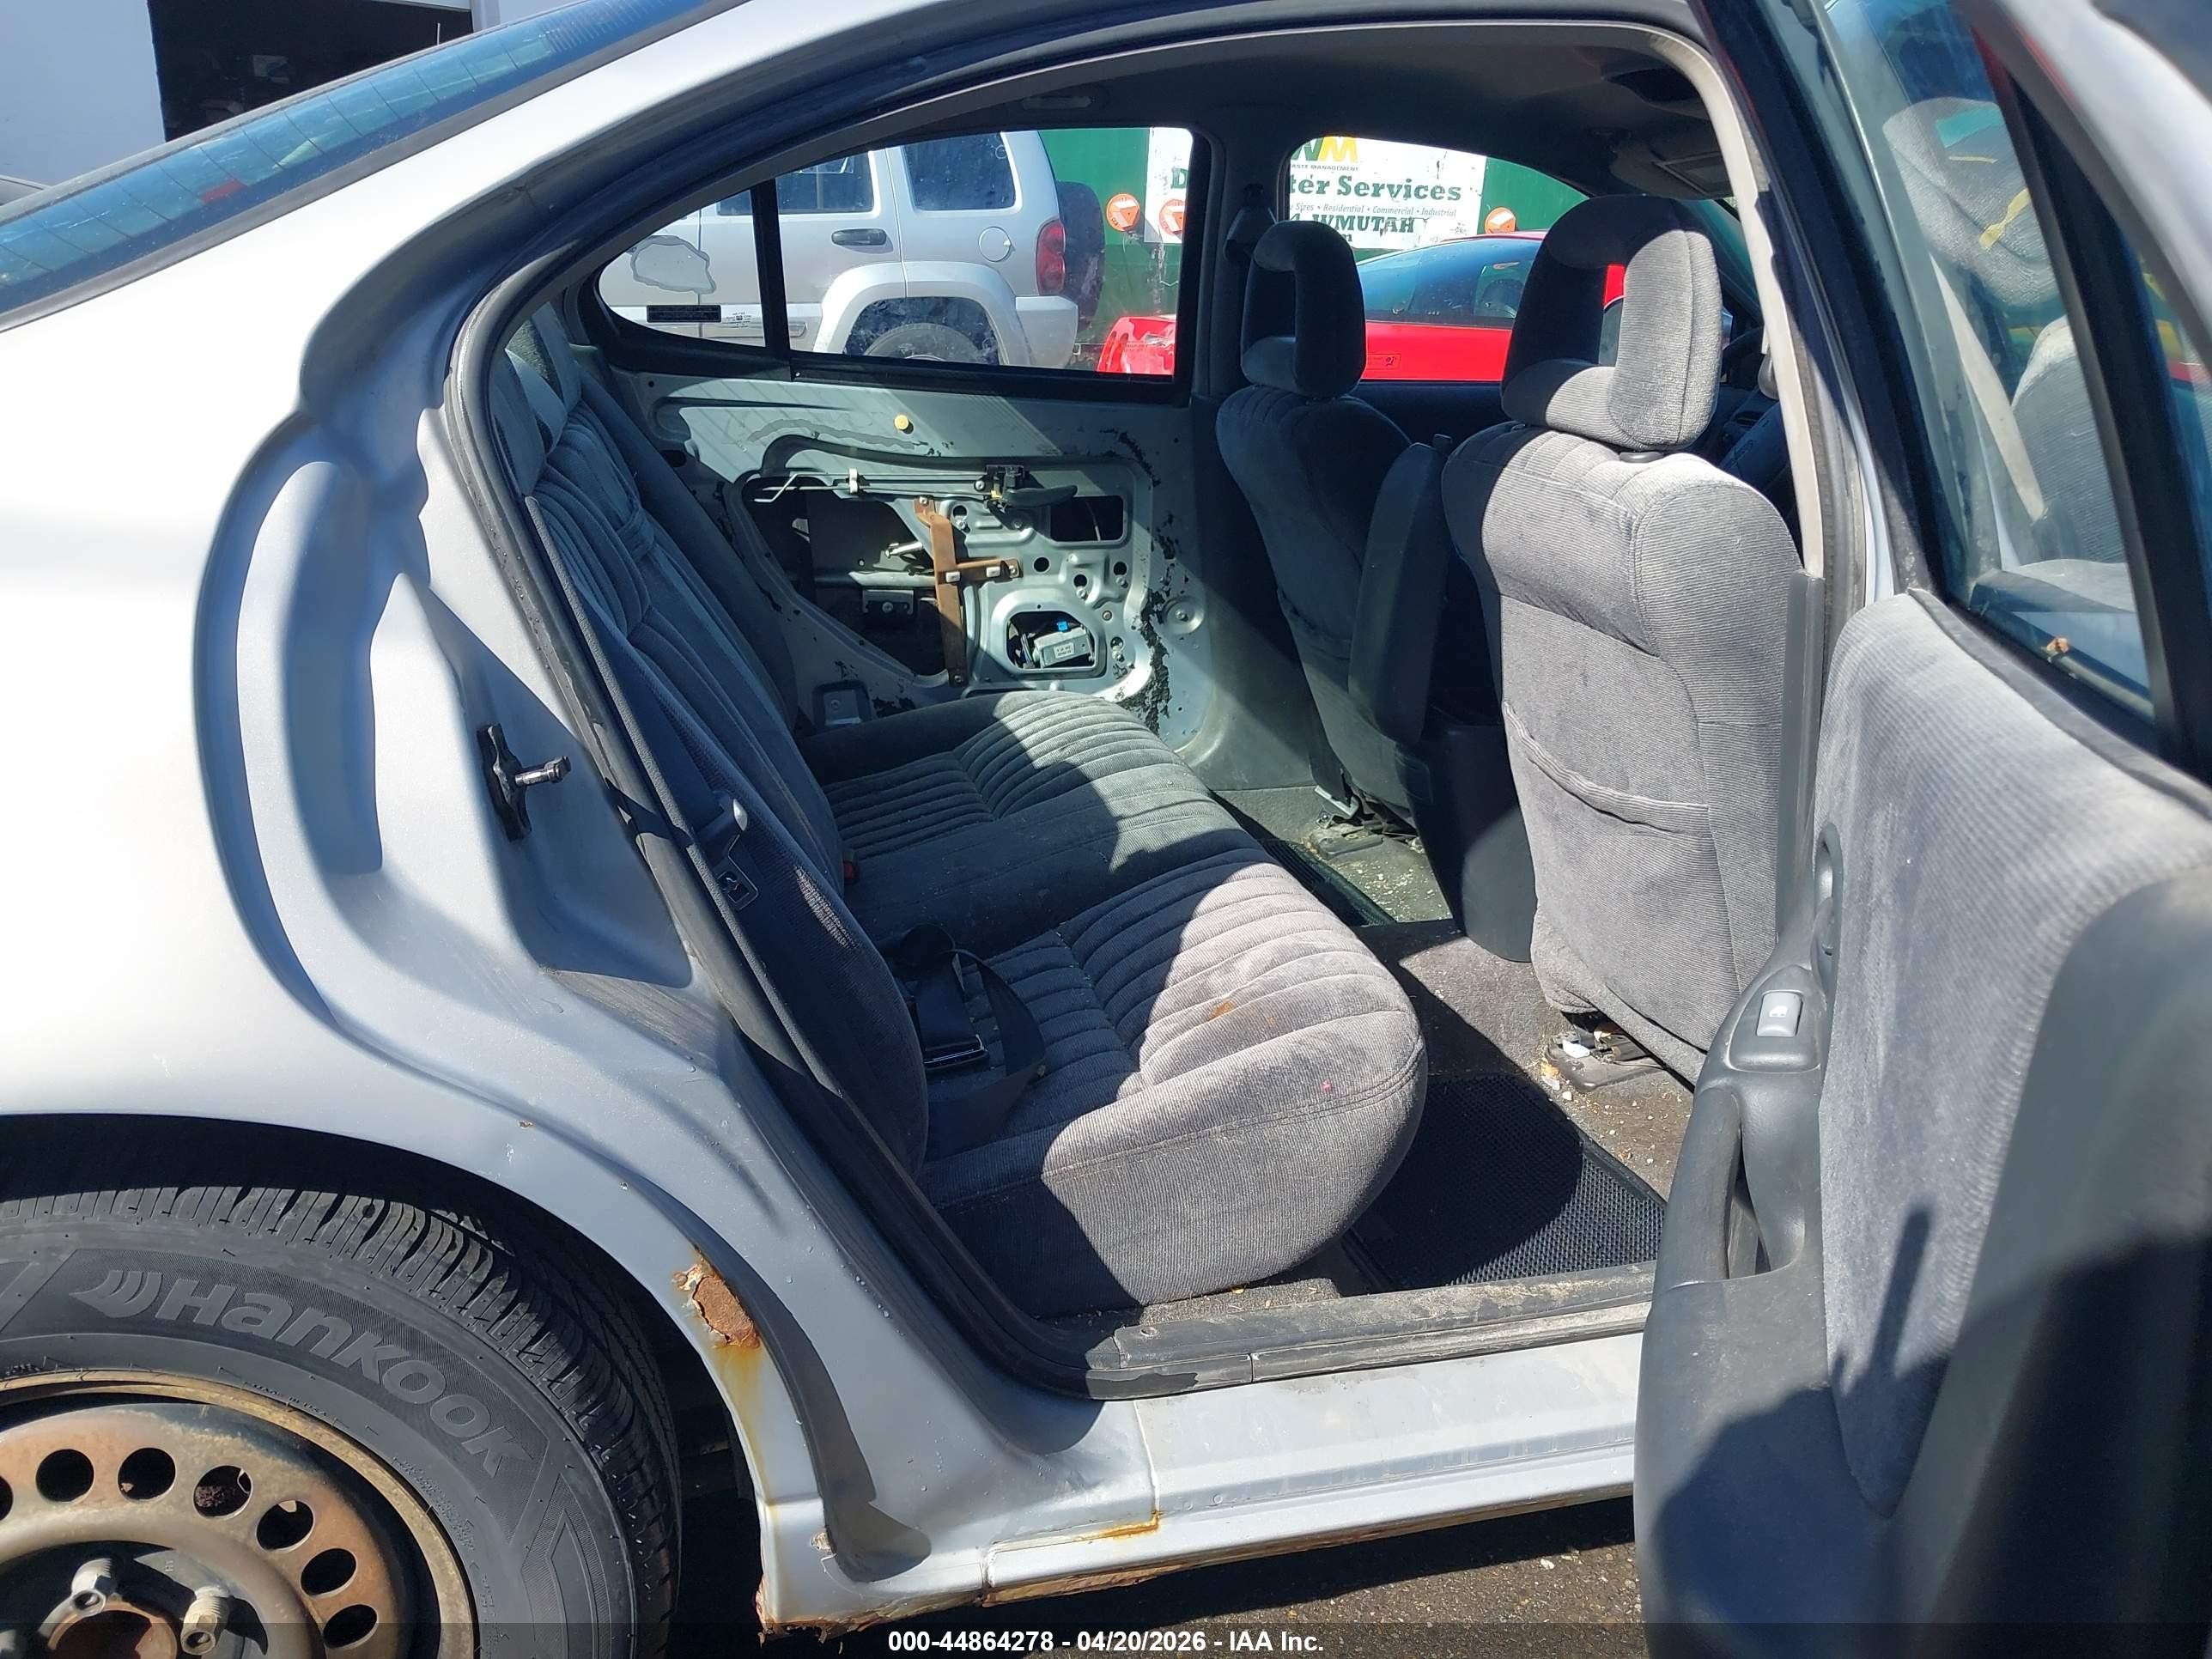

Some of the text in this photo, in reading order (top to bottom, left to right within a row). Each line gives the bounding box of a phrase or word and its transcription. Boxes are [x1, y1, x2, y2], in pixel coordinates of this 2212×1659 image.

[1337, 174, 1462, 200] Services
[1323, 204, 1364, 213] Residential
[1372, 205, 1413, 215] Commercial
[1421, 207, 1457, 217] Industrial
